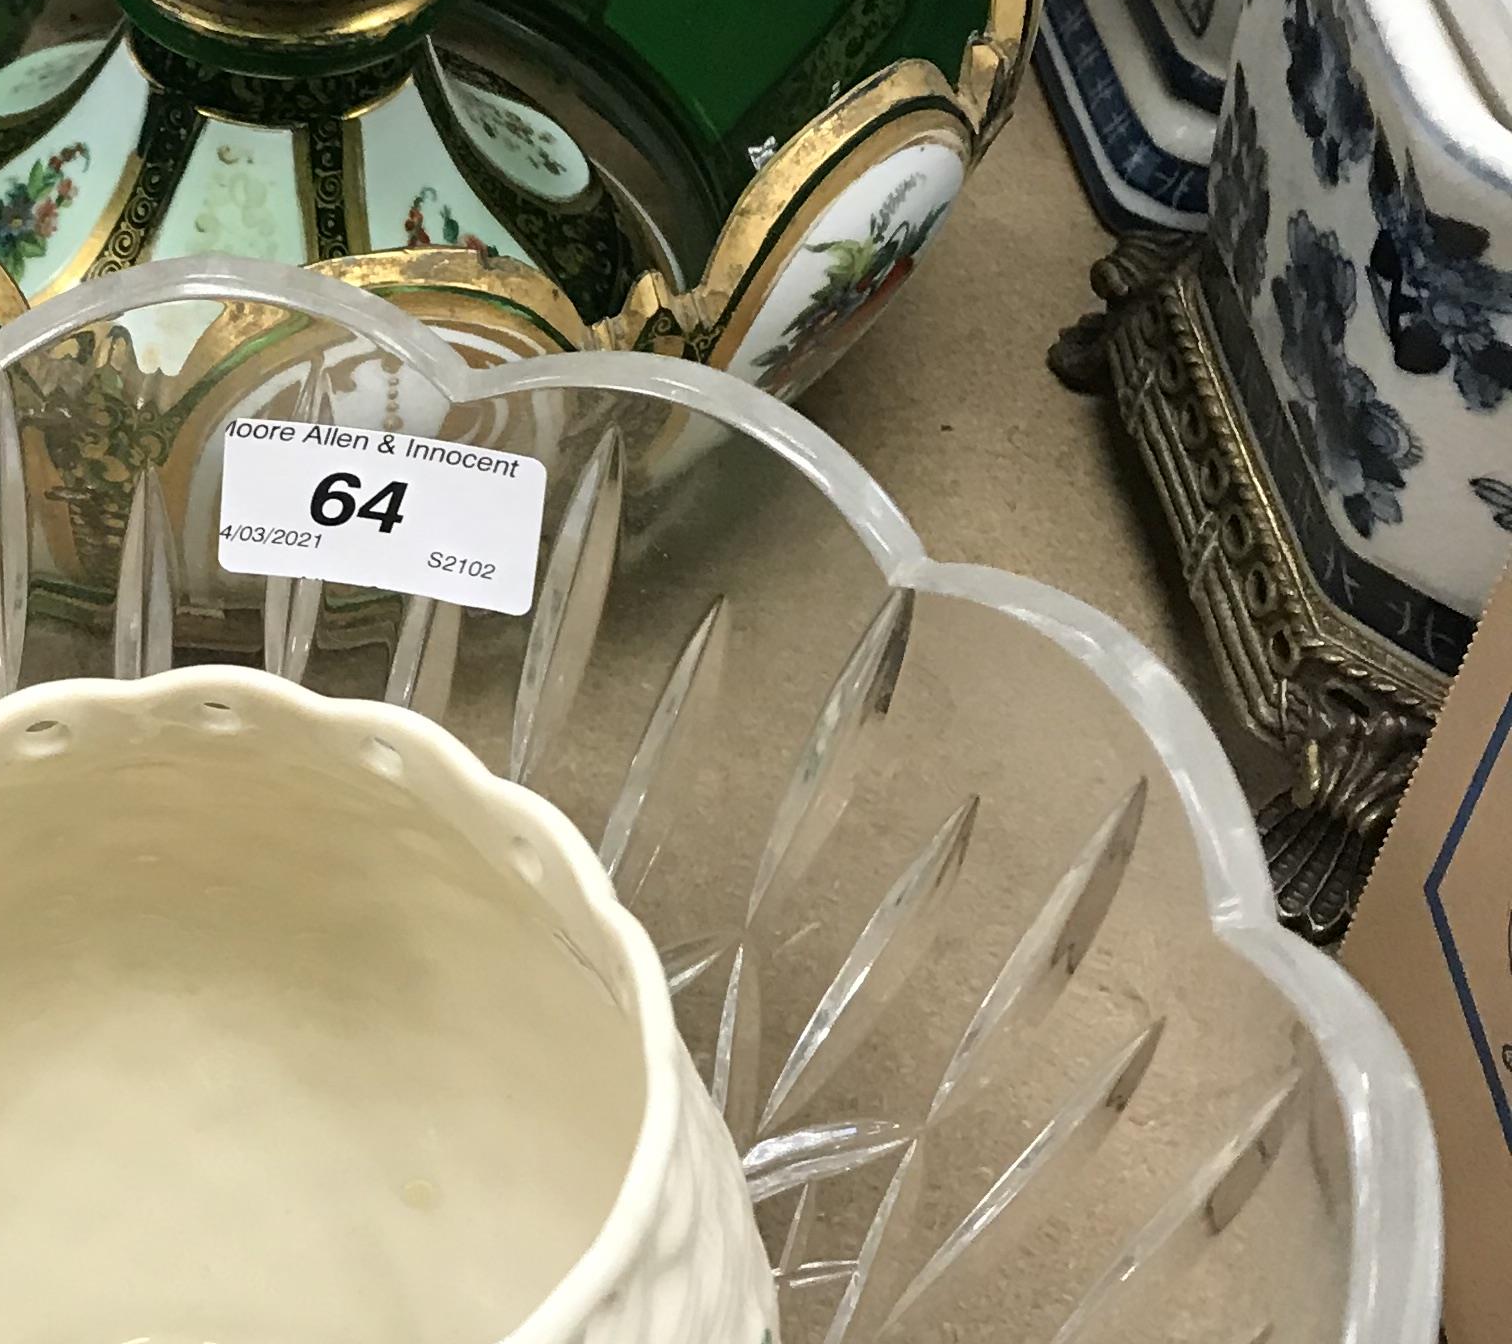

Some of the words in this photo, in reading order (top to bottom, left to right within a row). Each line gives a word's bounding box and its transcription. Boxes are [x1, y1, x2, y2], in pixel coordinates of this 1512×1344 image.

[302, 425, 370, 451] Allen
[377, 434, 396, 455] &
[405, 438, 521, 478] Innocent
[309, 471, 409, 534] 64
[426, 551, 497, 580] S2102
